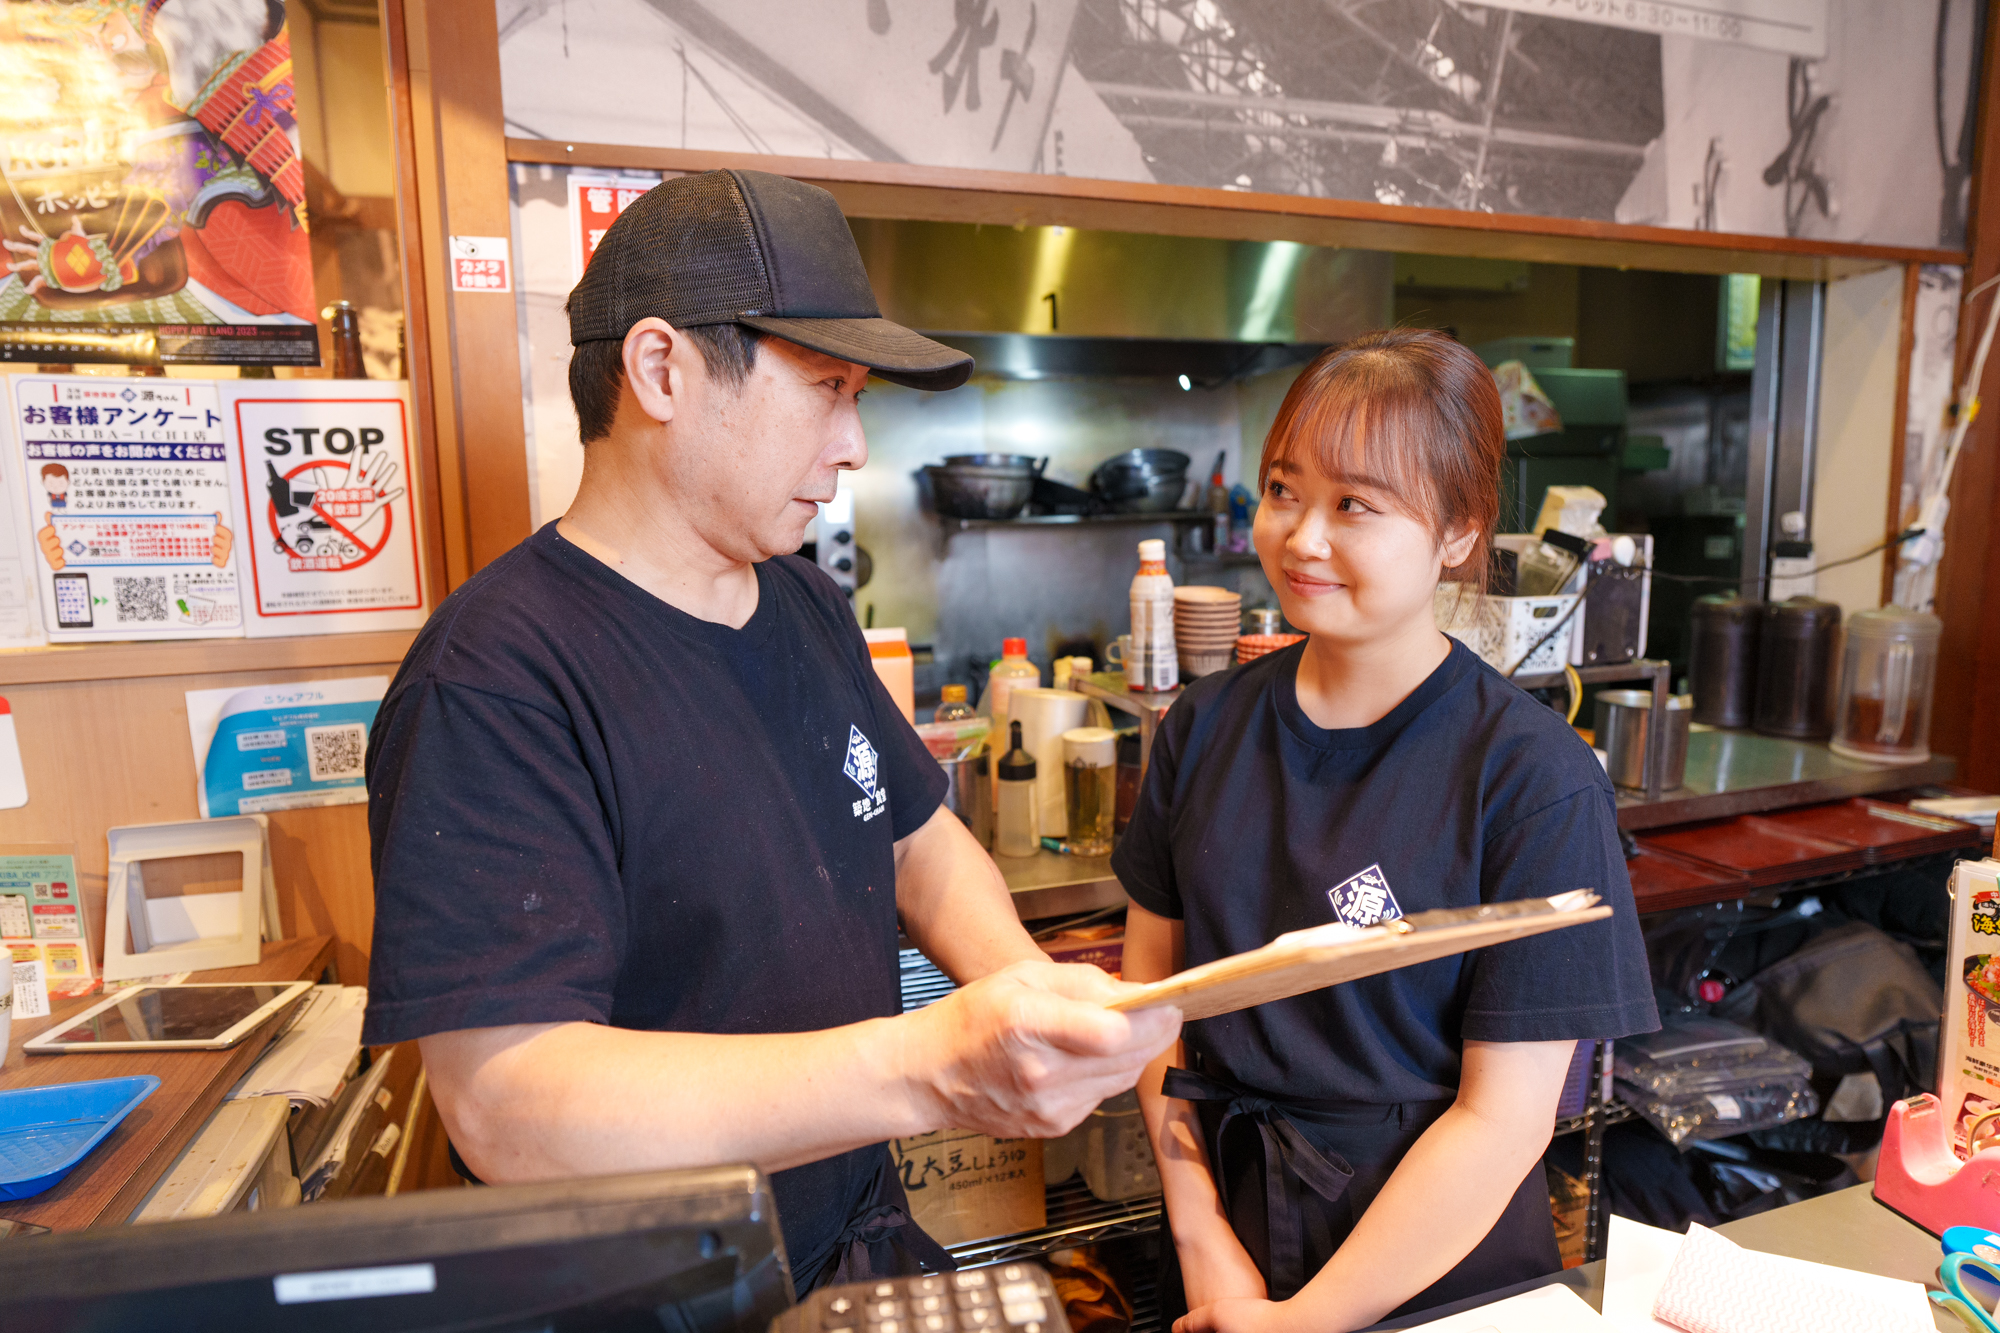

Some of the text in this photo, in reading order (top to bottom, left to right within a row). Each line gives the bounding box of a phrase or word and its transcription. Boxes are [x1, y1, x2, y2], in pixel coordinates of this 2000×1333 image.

[460, 260, 500, 274] カメラ
[461, 275, 501, 288] 作動中
[158, 325, 188, 336] HOPPY
[189, 325, 209, 336] ART
[210, 326, 235, 336] LAND
[236, 326, 258, 336] 2023
[24, 405, 221, 428] お客様アンケート
[264, 427, 384, 457] STOP
[27, 443, 225, 459] お客様の声をお聞かせください
[317, 489, 374, 503] 20歳未満
[333, 503, 361, 517] 飲酒
[289, 556, 343, 571] 飲酒運転
[1340, 881, 1387, 926] 源
[1973, 913, 2000, 936] 海
